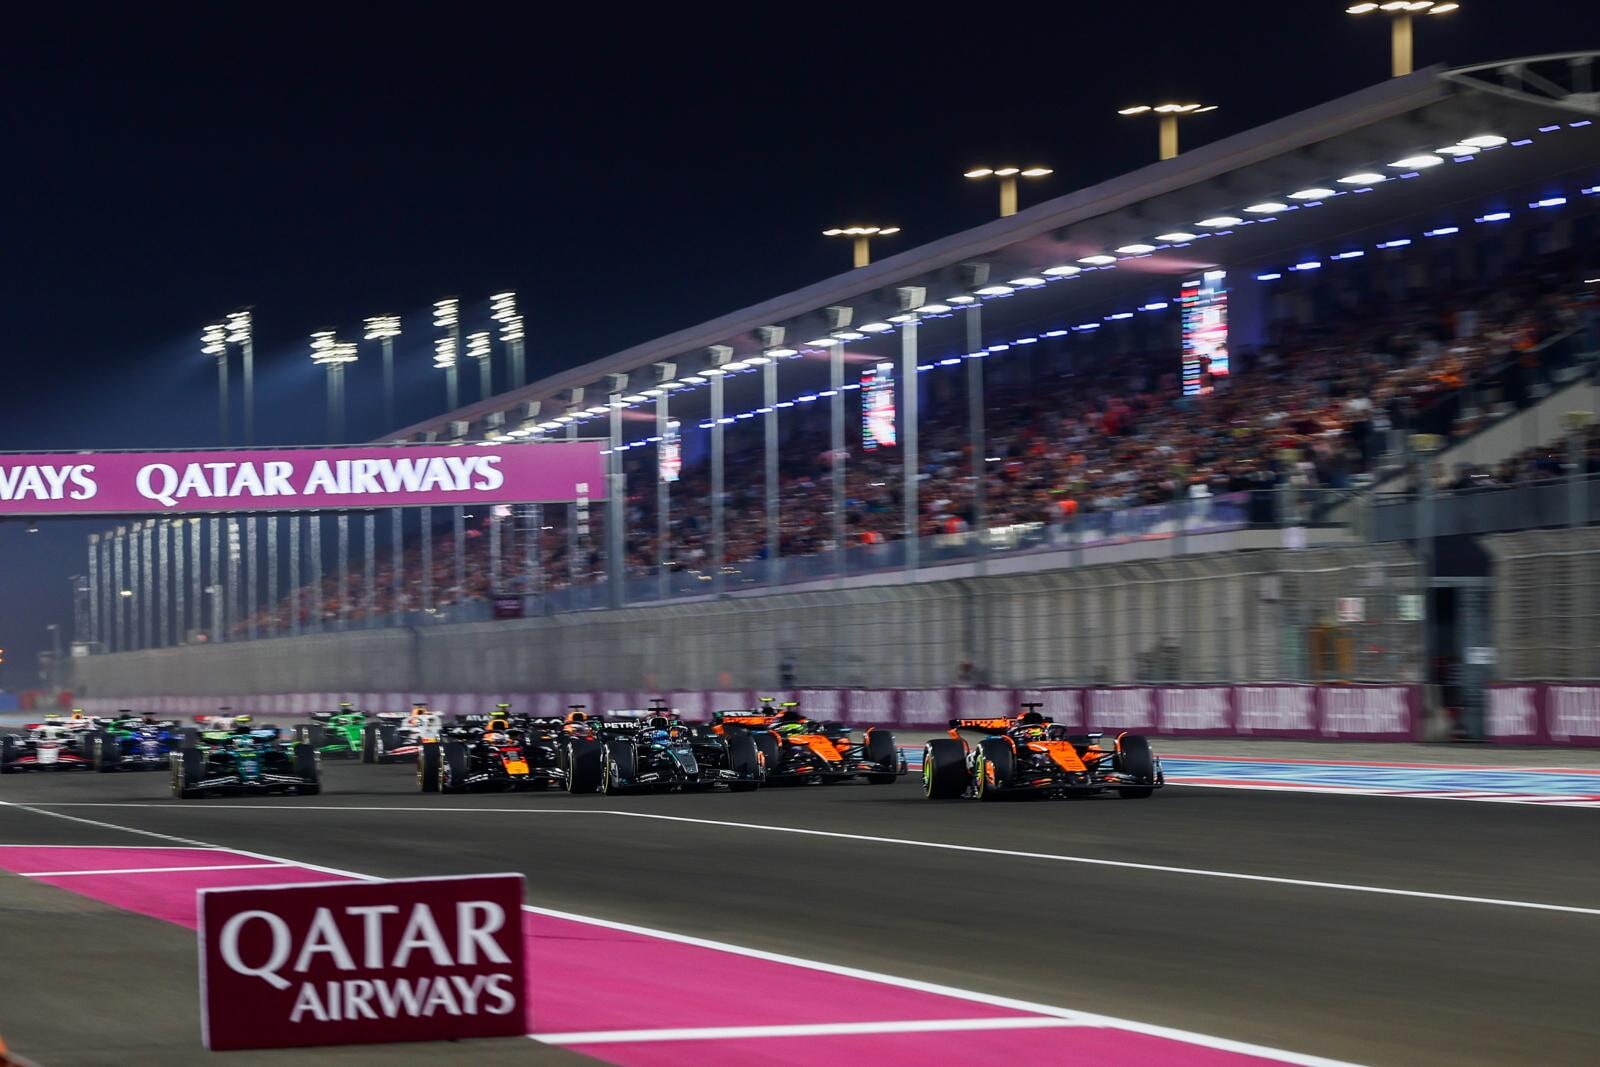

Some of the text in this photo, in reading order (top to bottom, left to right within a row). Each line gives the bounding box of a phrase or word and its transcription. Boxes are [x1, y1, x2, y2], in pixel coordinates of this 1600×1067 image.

[136, 455, 504, 507] QATAR AIRWAYS
[220, 901, 512, 991] QATAR
[289, 974, 516, 1023] AIRWAYS
